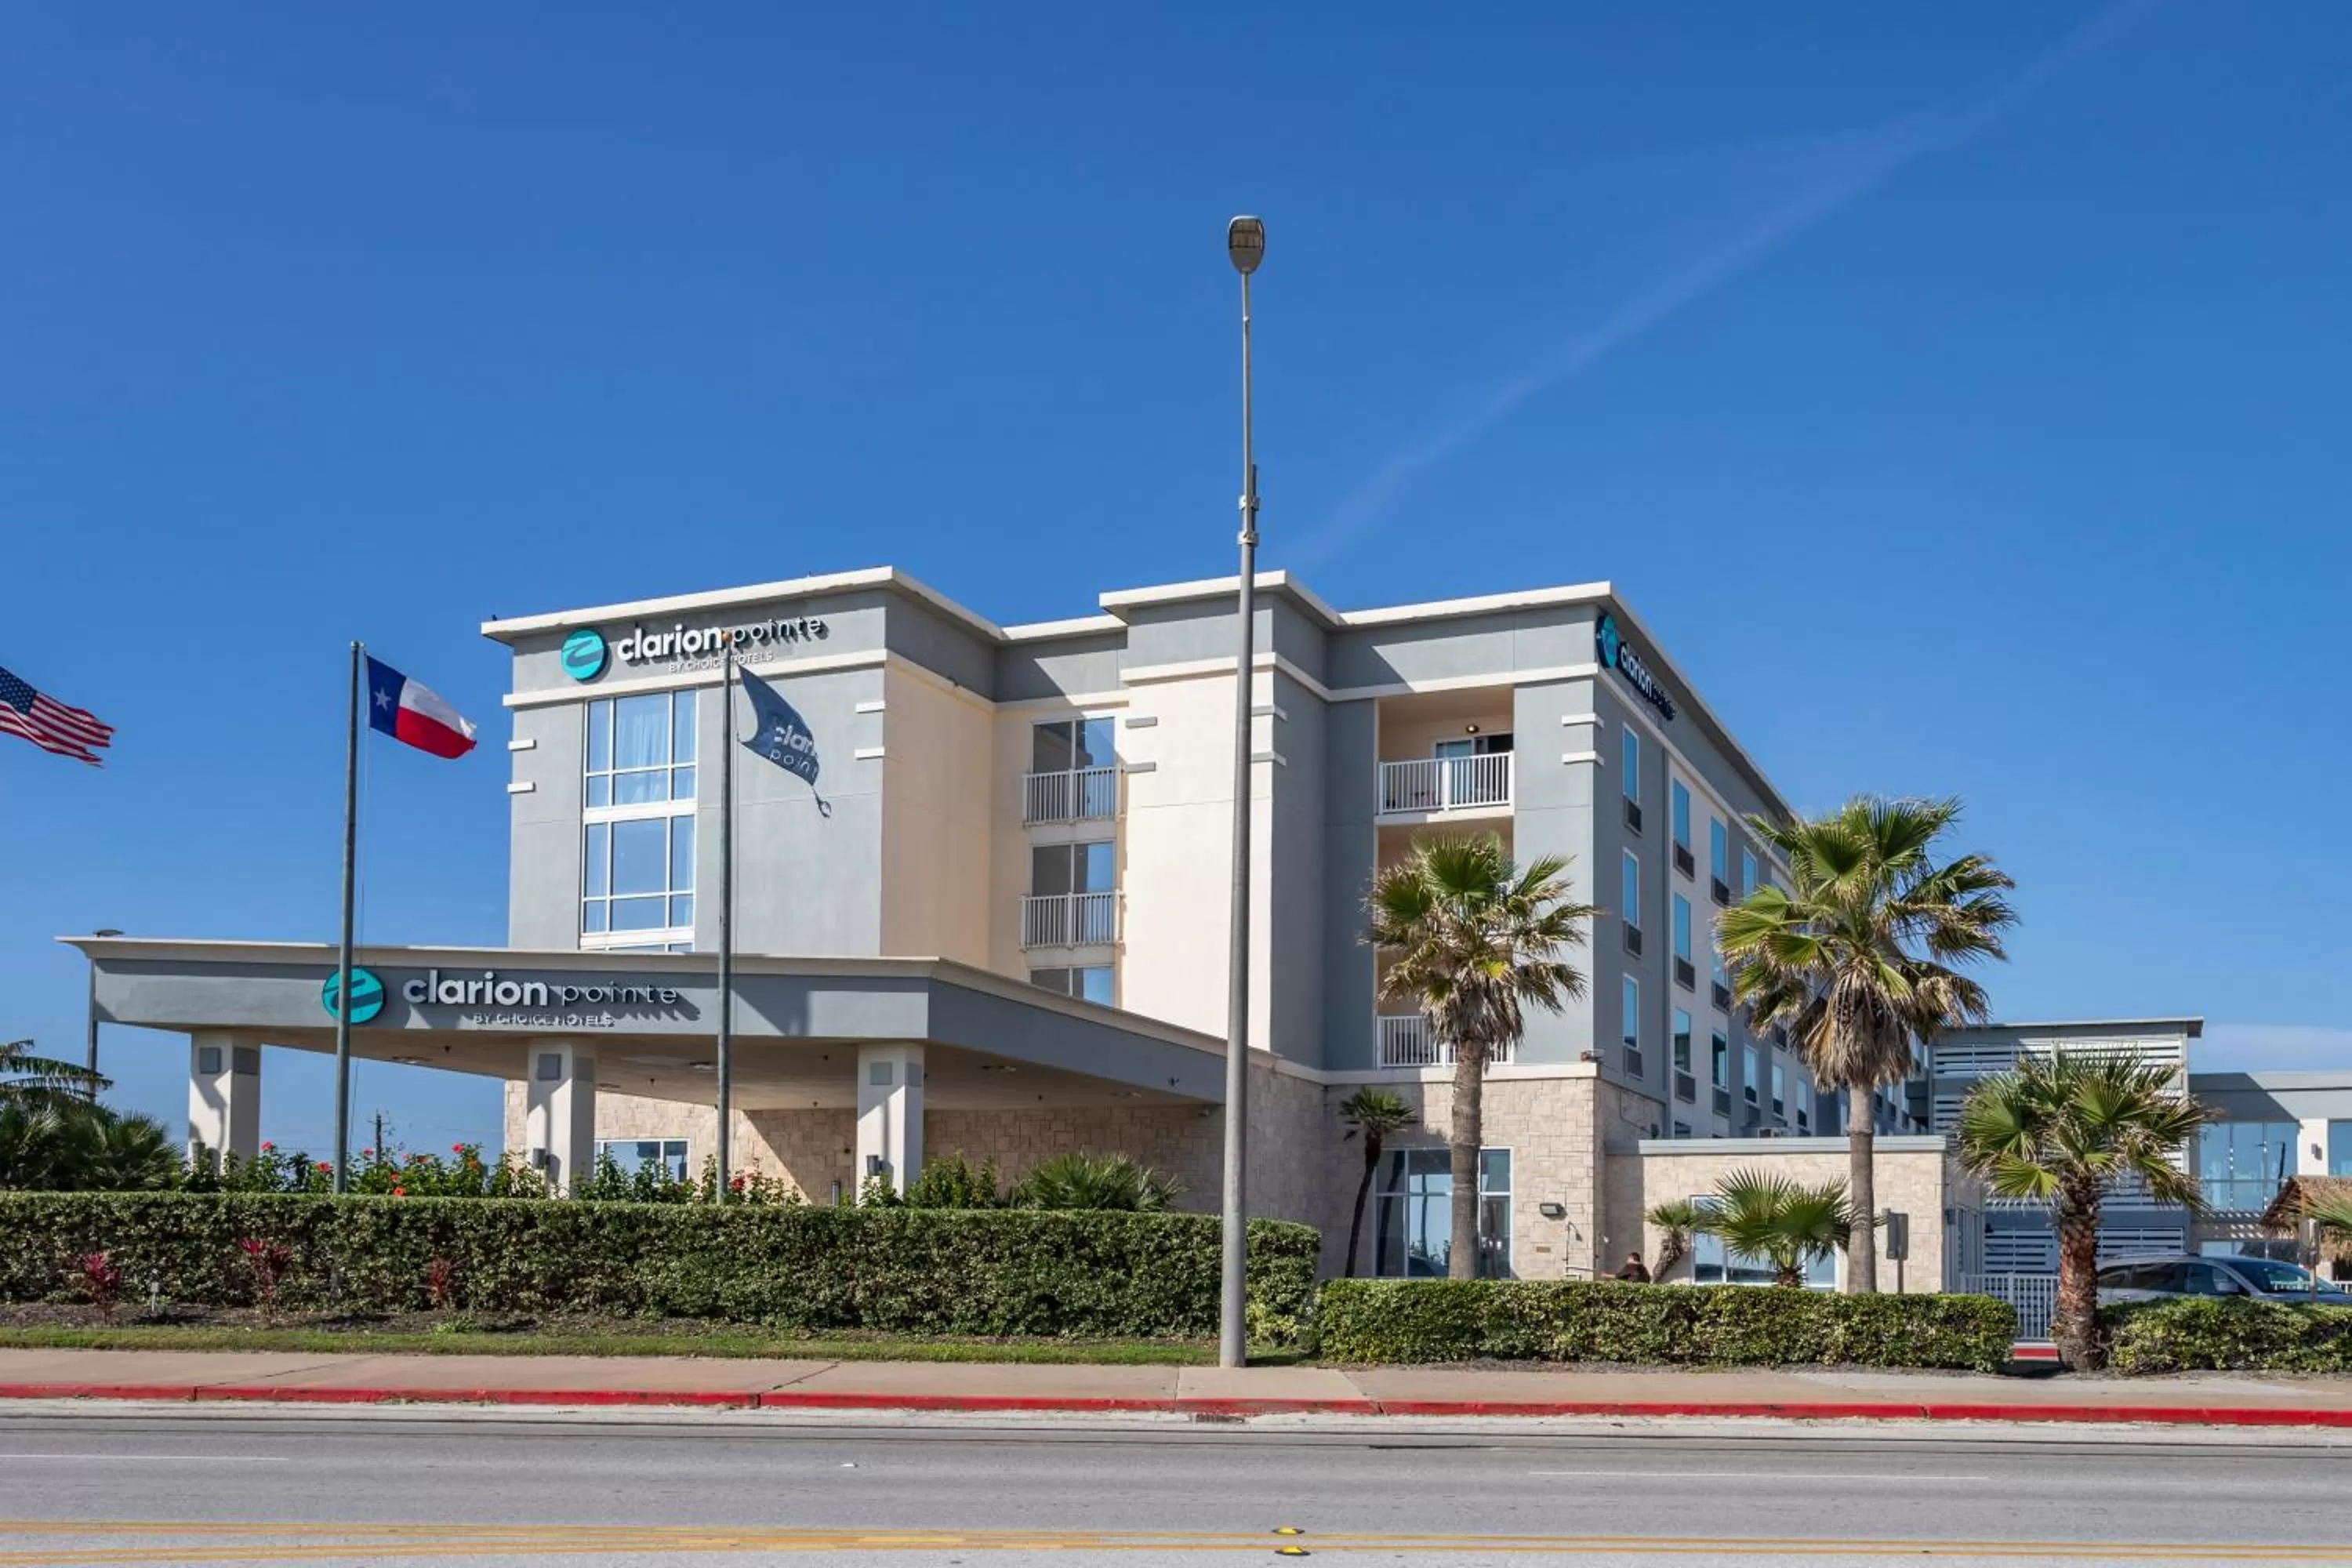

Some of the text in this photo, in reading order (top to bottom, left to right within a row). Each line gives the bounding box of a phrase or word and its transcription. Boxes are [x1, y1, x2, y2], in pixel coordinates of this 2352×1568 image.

[617, 617, 822, 662] clarion pointe
[402, 969, 678, 1006] clarion pointe
[474, 1013, 615, 1026] BY CHOICE HOTELS
